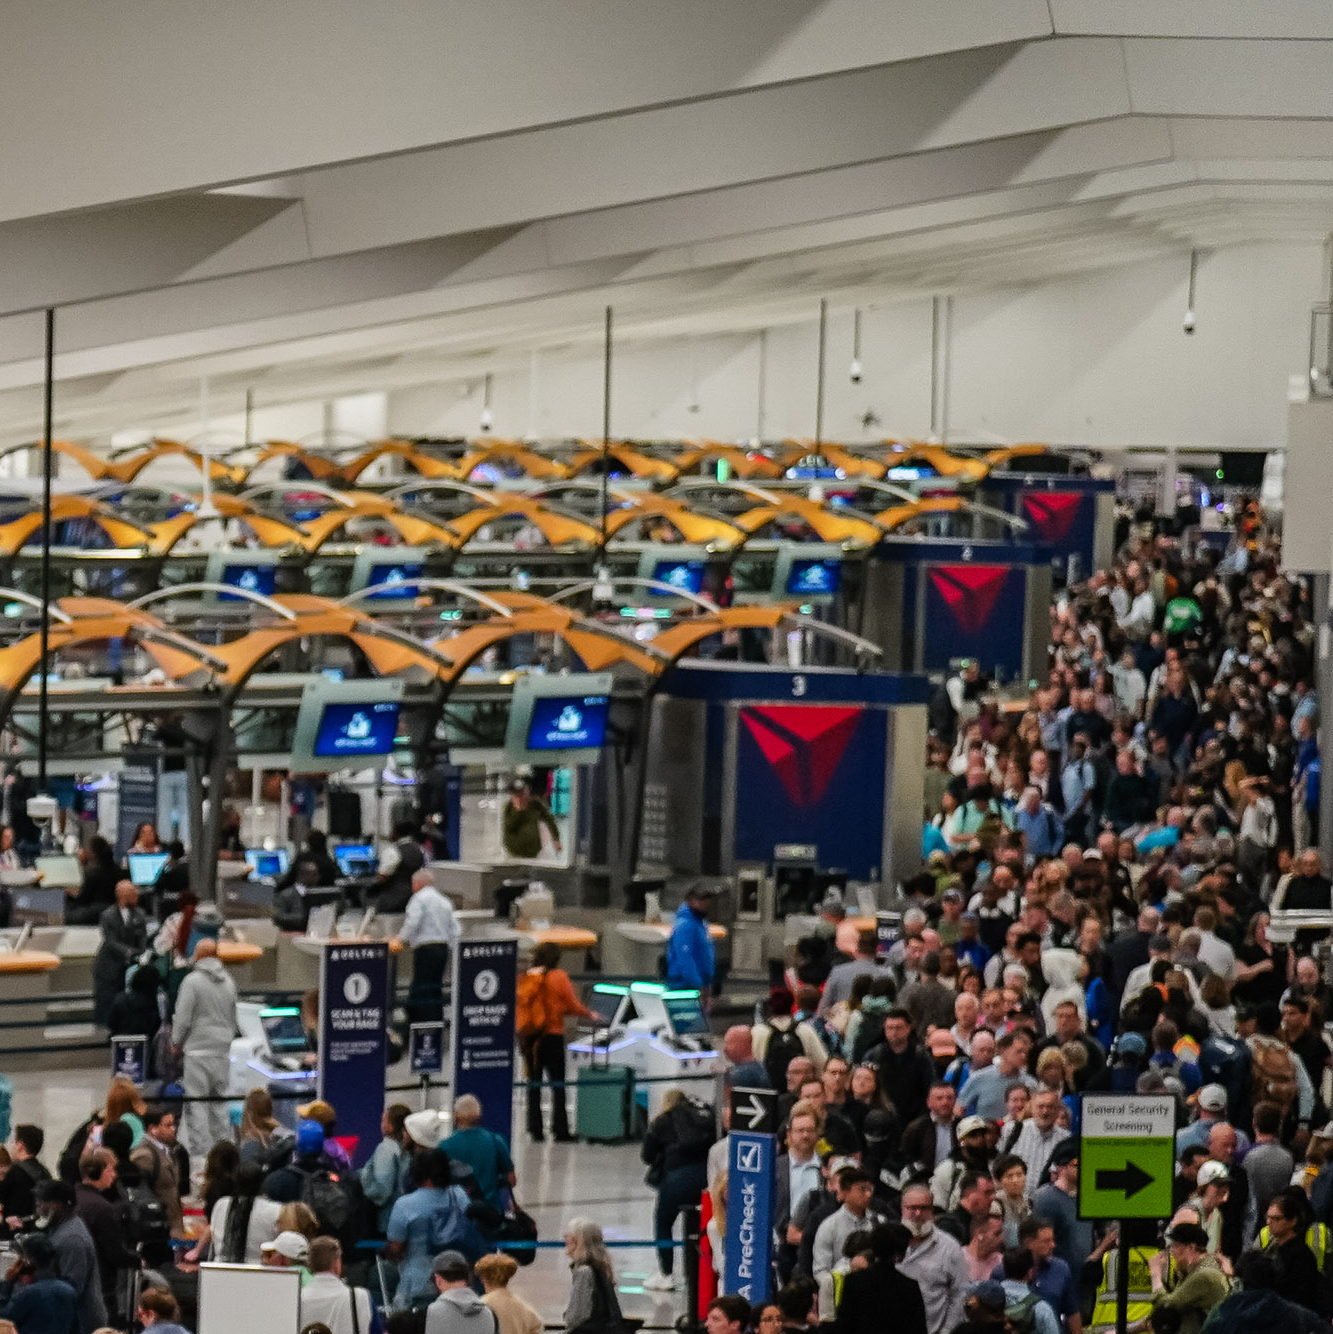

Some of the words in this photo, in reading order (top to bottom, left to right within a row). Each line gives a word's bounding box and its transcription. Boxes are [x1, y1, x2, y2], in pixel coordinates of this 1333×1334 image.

[792, 677, 806, 696] 3
[1087, 1103, 1125, 1116] General
[1129, 1103, 1169, 1117] Security
[1103, 1120, 1152, 1135] Screening
[738, 1182, 755, 1278] PreCheck
